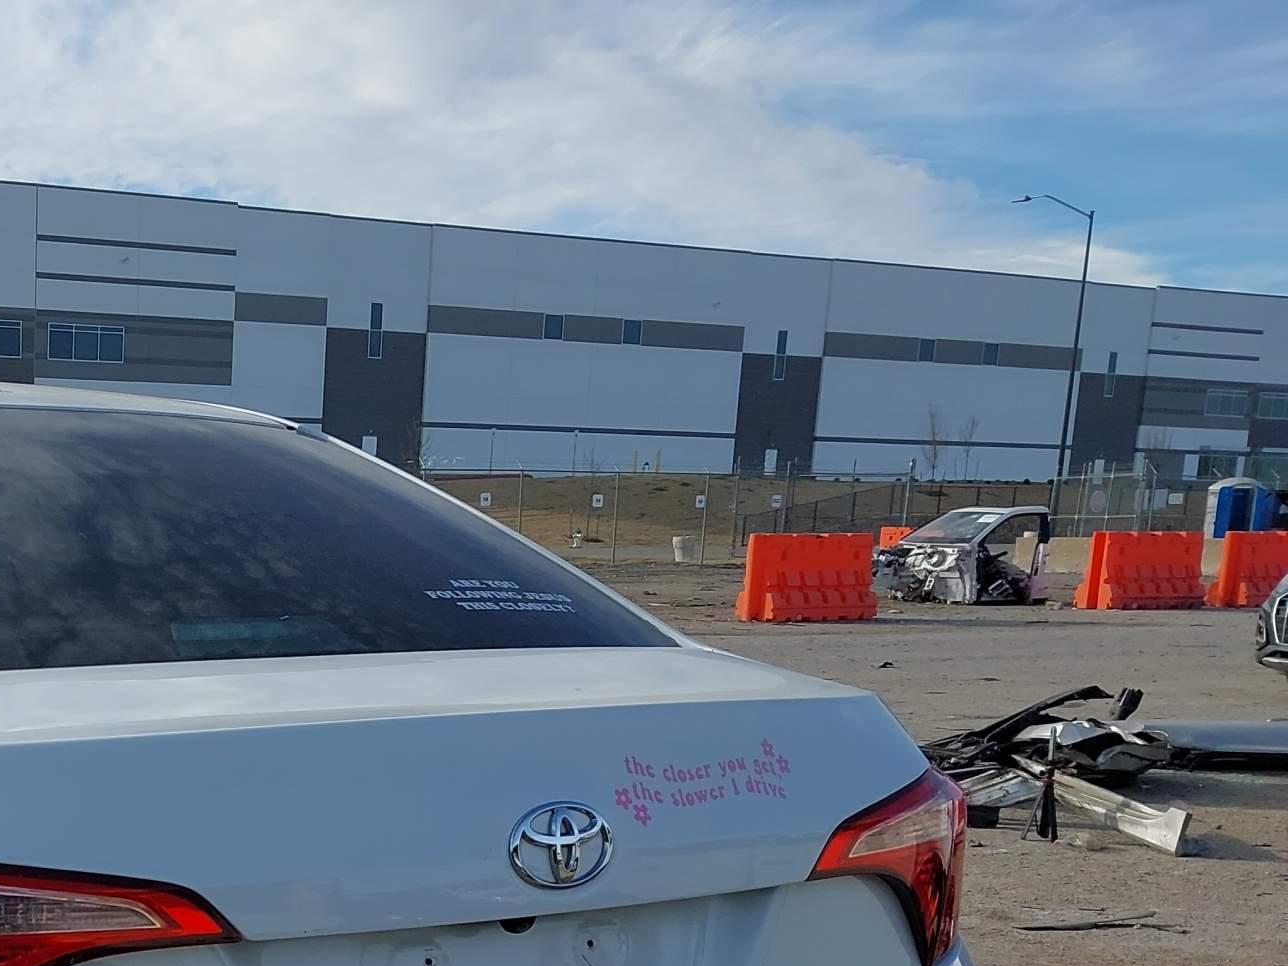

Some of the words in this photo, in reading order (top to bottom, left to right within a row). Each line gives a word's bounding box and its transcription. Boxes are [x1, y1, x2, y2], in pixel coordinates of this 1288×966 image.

[483, 580, 519, 589] YOU
[424, 590, 522, 599] FOLLOWING
[457, 601, 501, 611] THIS
[624, 756, 655, 778] the
[663, 764, 712, 783] closer
[718, 756, 747, 778] you
[632, 782, 663, 803] the
[670, 785, 725, 807] slower
[745, 775, 787, 799] drive
